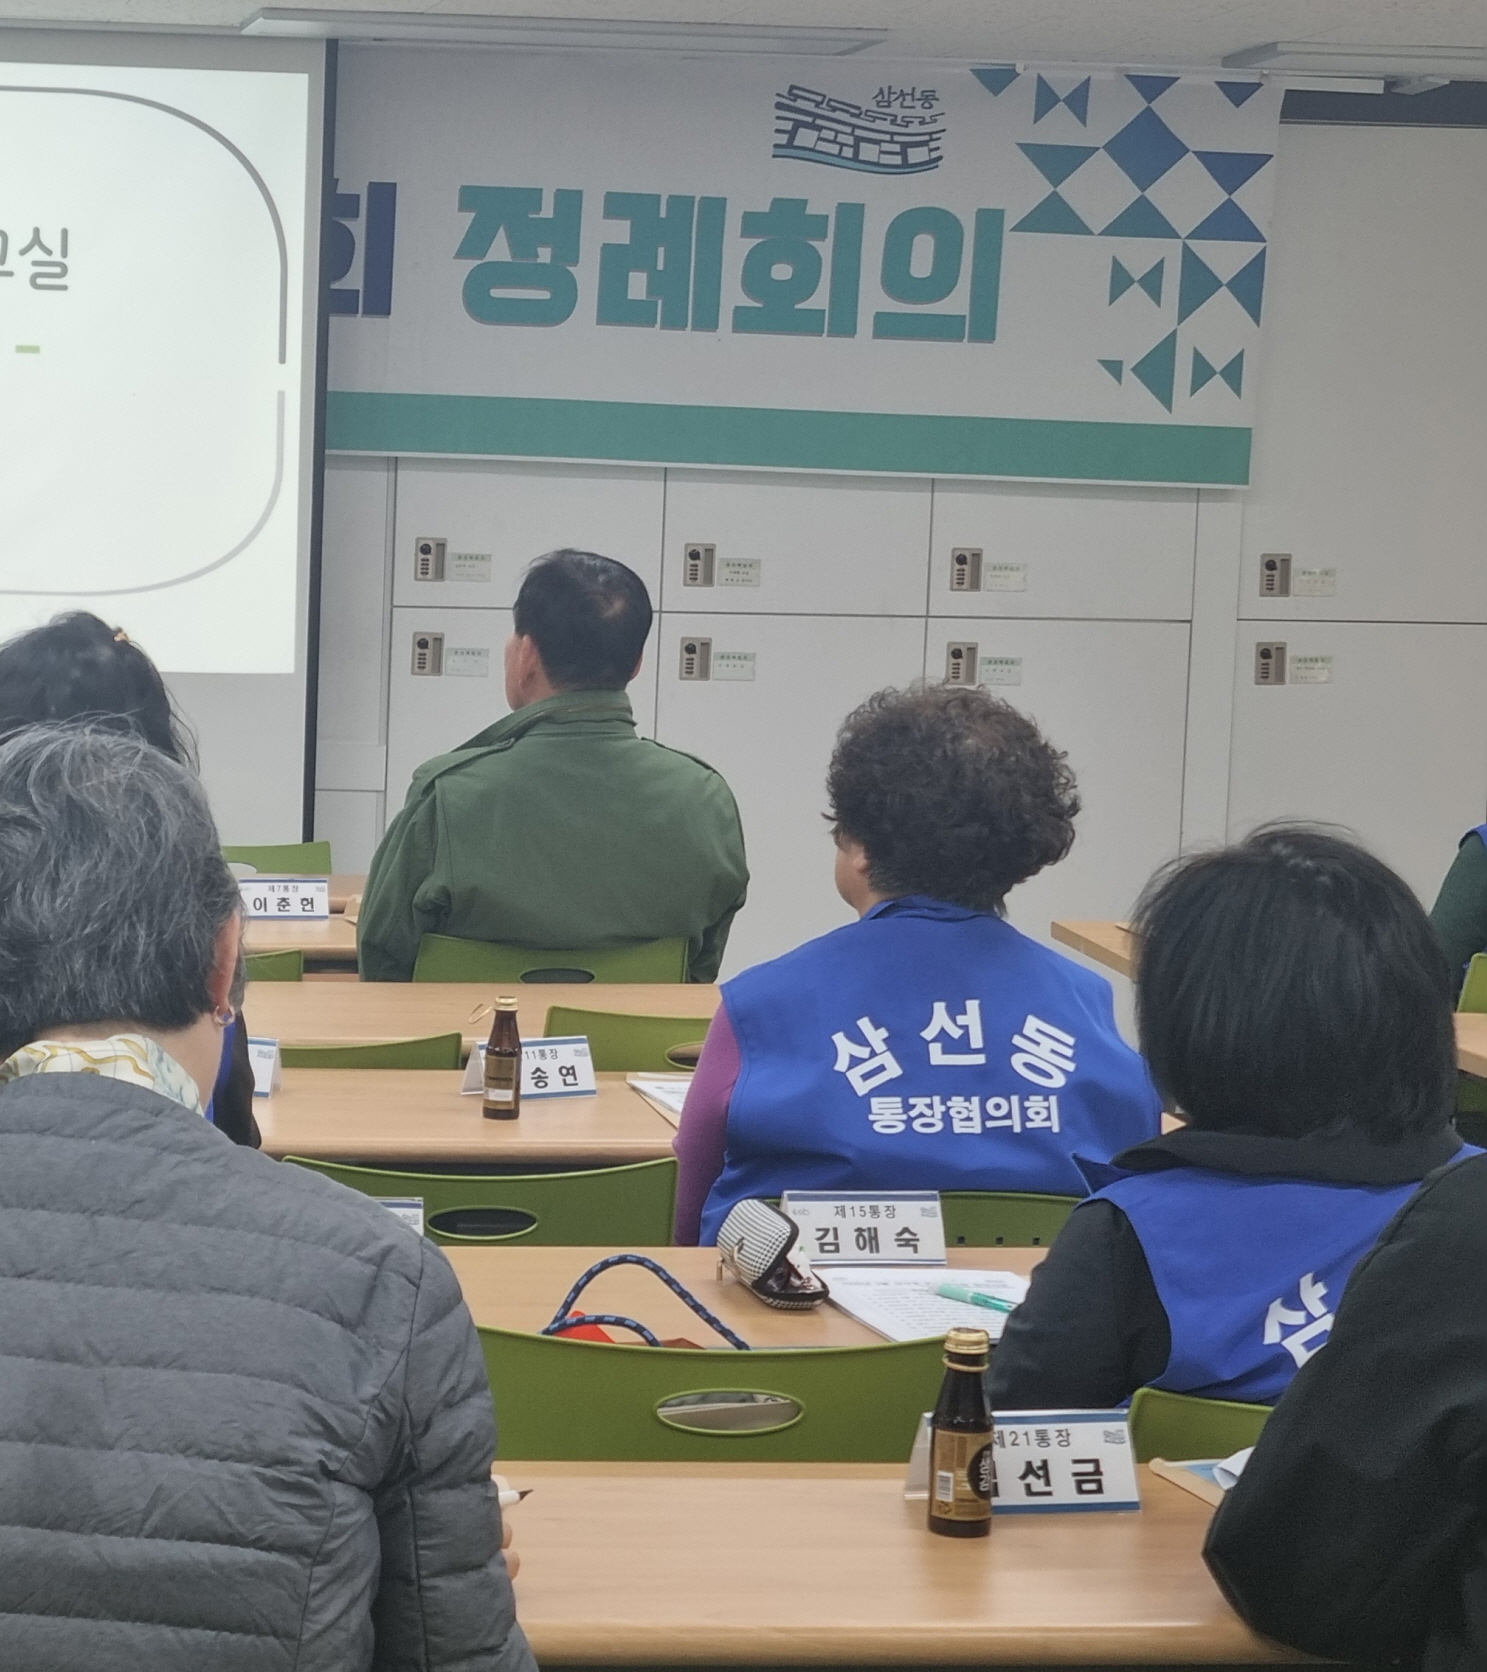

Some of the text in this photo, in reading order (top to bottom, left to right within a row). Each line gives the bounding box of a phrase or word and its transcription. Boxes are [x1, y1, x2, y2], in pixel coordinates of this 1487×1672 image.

[872, 85, 940, 109] 삼선동
[453, 184, 1006, 344] 정례회의
[524, 1048, 559, 1060] 11통장
[831, 999, 1077, 1098] 삼선동
[530, 1065, 579, 1089] 송연
[868, 1095, 1061, 1134] 통장협의회
[833, 1205, 897, 1219] 제15통장
[814, 1227, 920, 1254] 김해숙
